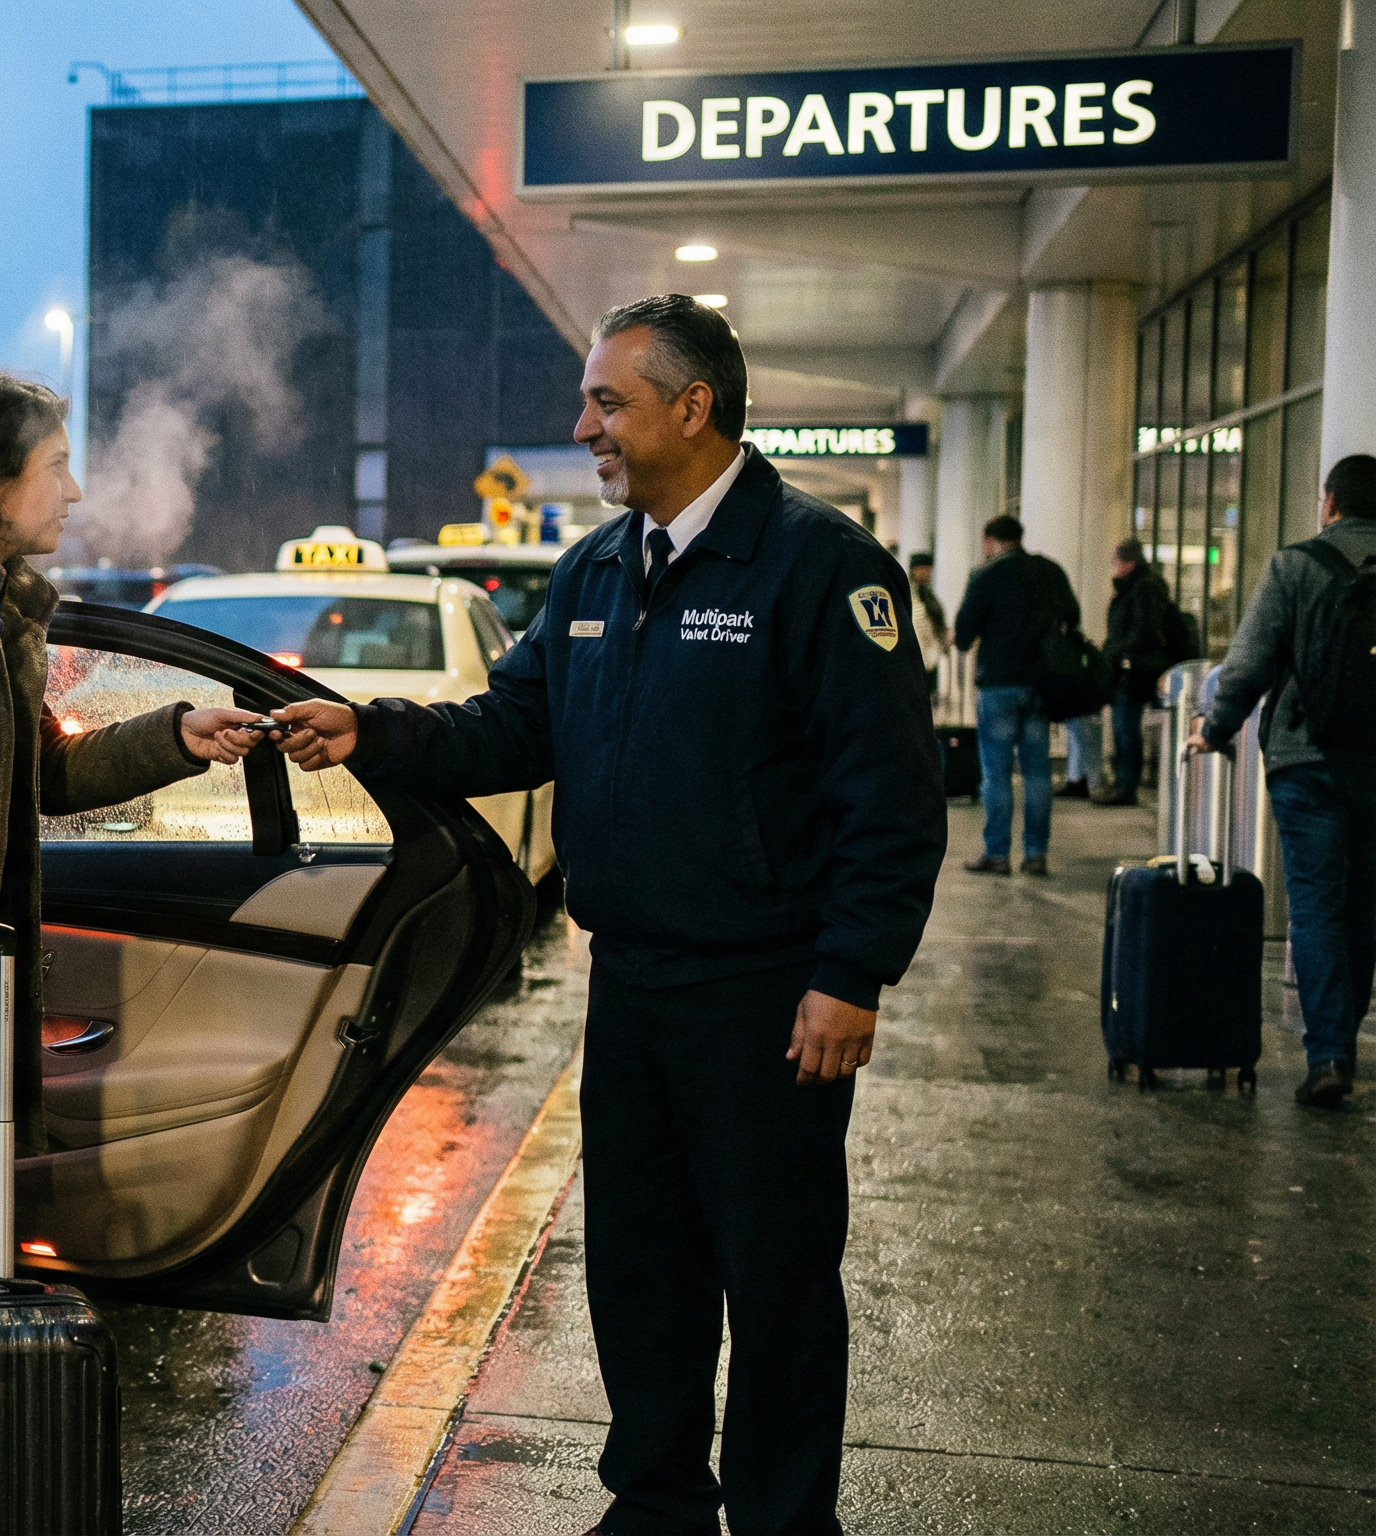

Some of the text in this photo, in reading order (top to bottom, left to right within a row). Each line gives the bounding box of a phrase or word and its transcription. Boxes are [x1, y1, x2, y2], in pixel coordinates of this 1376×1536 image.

[641, 79, 1157, 162] DEPARTURES
[296, 543, 359, 564] TAXI
[681, 608, 754, 629] Multipark
[711, 627, 751, 644] Driver
